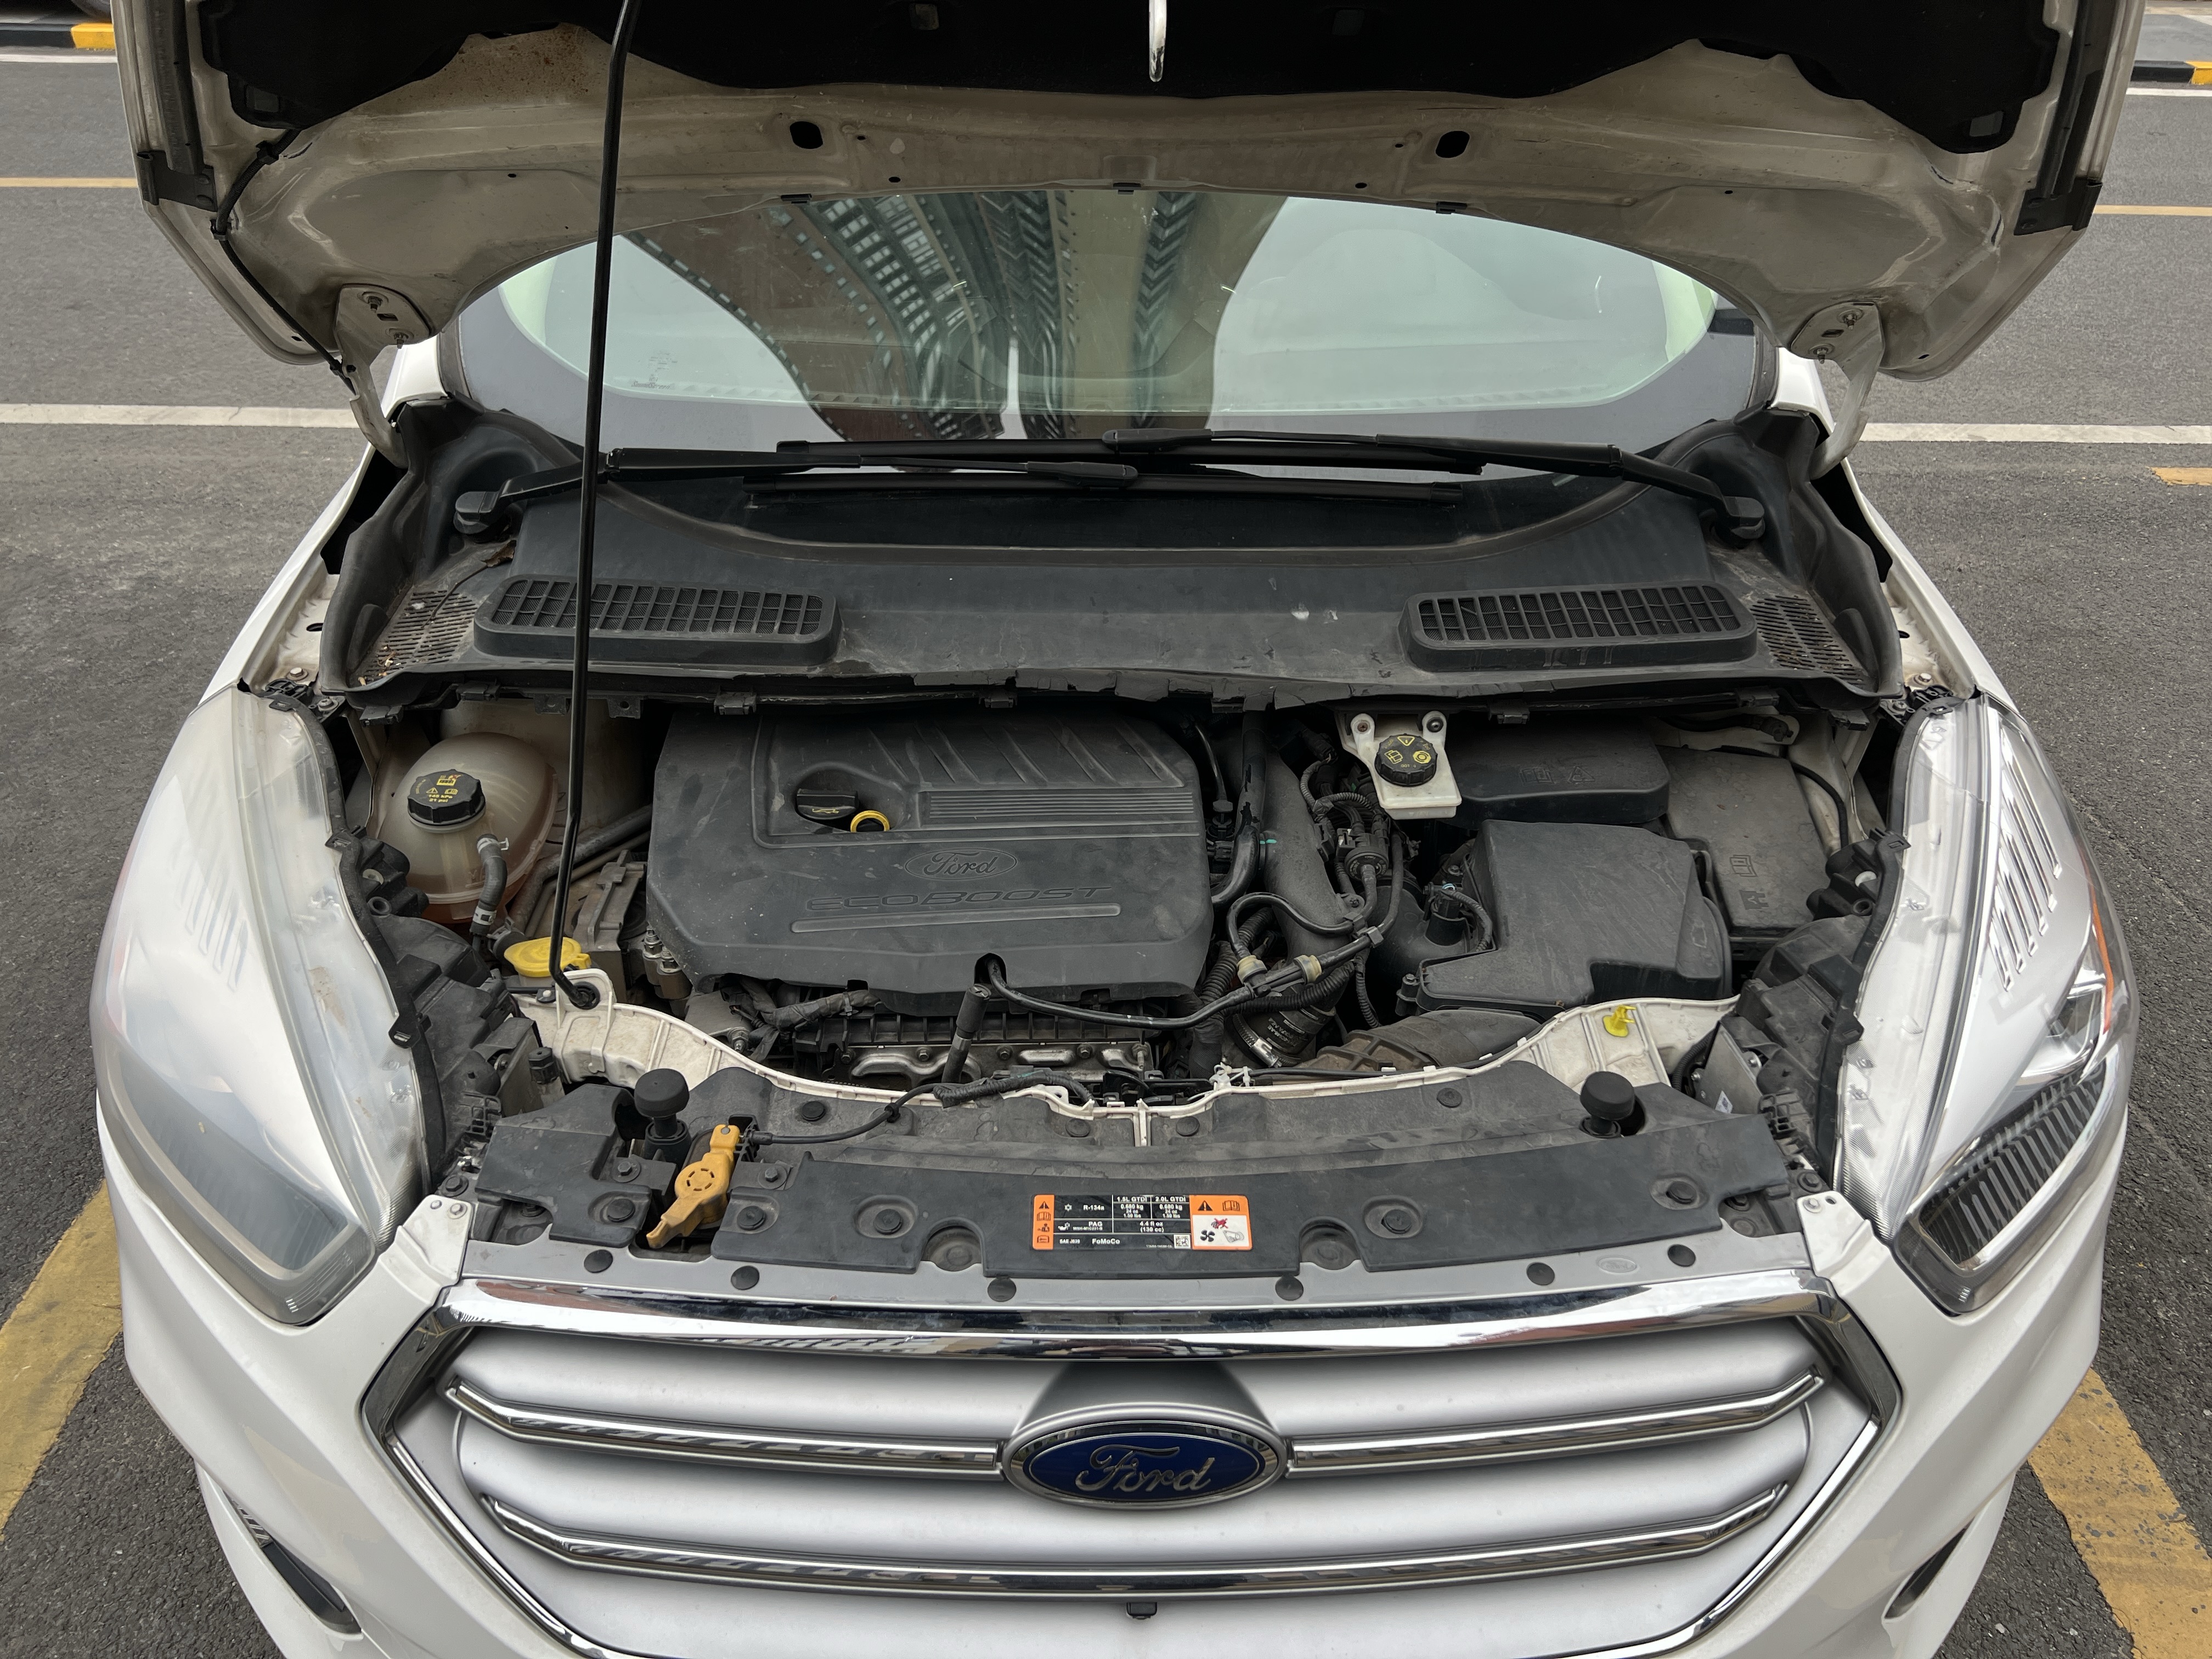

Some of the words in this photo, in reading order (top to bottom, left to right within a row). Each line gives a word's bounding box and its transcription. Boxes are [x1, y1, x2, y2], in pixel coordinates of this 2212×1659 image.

[631, 381, 670, 390] SoundScreen
[923, 851, 998, 876] Ford
[1075, 1444, 1215, 1492] Ford
